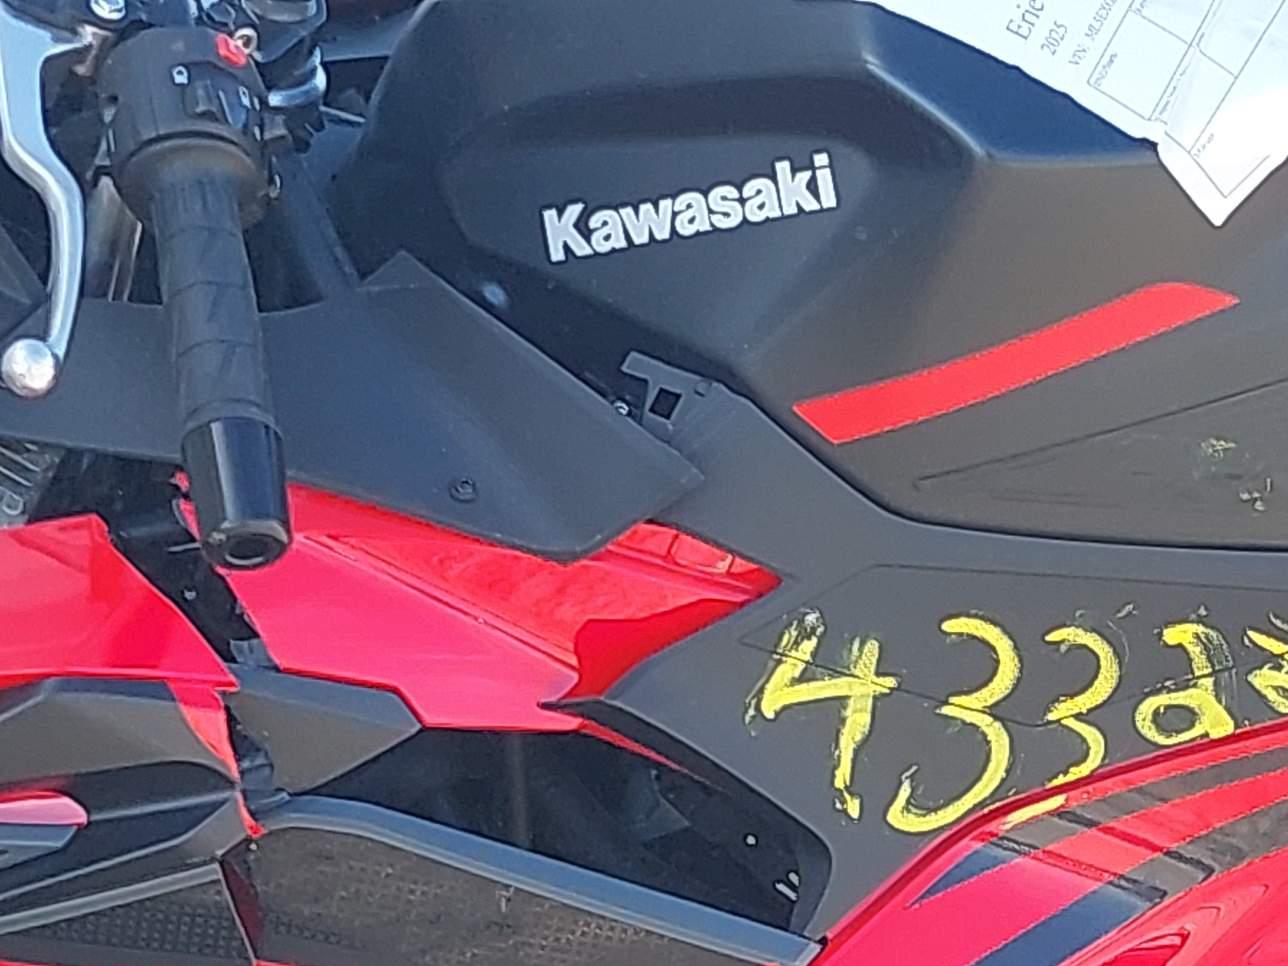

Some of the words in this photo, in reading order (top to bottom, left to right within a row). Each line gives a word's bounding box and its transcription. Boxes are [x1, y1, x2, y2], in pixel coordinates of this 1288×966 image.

[1005, 0, 1044, 40] Erie
[1040, 20, 1068, 56] 2025
[541, 151, 838, 263] Kawasaki
